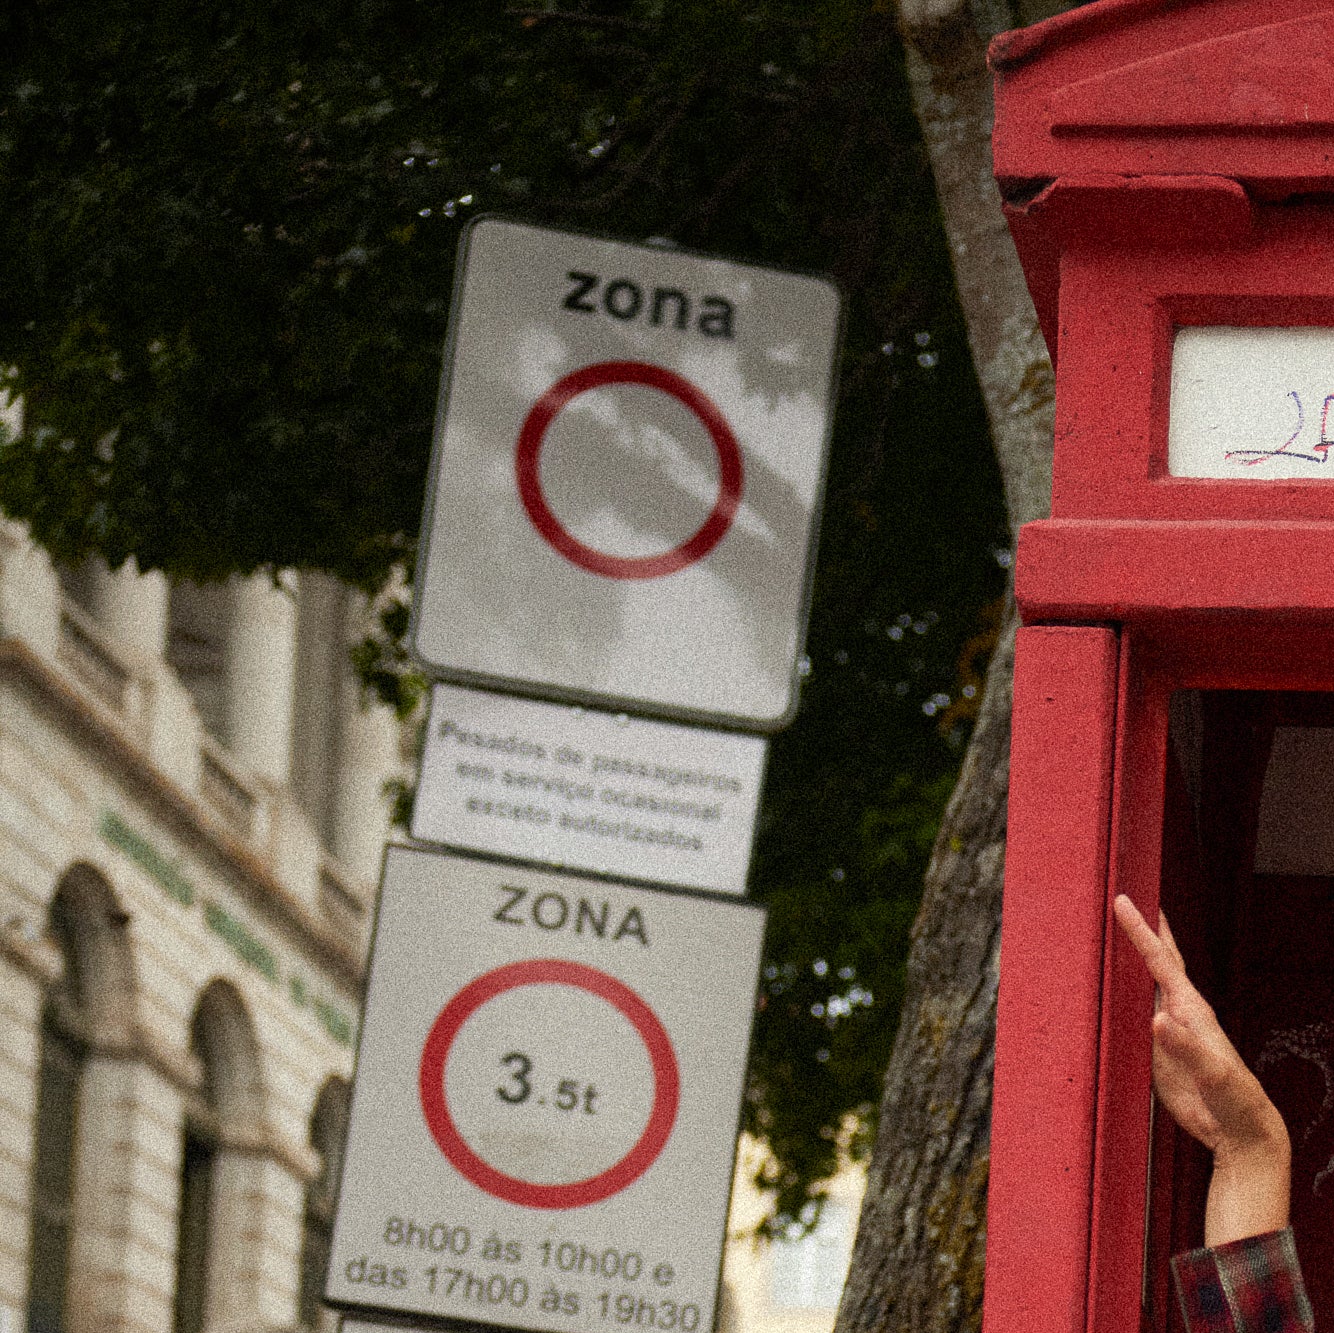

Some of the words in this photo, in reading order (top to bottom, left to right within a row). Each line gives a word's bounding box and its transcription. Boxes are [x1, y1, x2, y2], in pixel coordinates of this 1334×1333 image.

[563, 270, 736, 340] zona
[493, 885, 650, 947] ZONA
[383, 1214, 471, 1256] 8h00
[539, 1239, 642, 1282] 10h00
[653, 1262, 676, 1287] e
[345, 1254, 408, 1289] das
[424, 1265, 530, 1308] 17h00
[600, 1293, 700, 1333] 19h30
